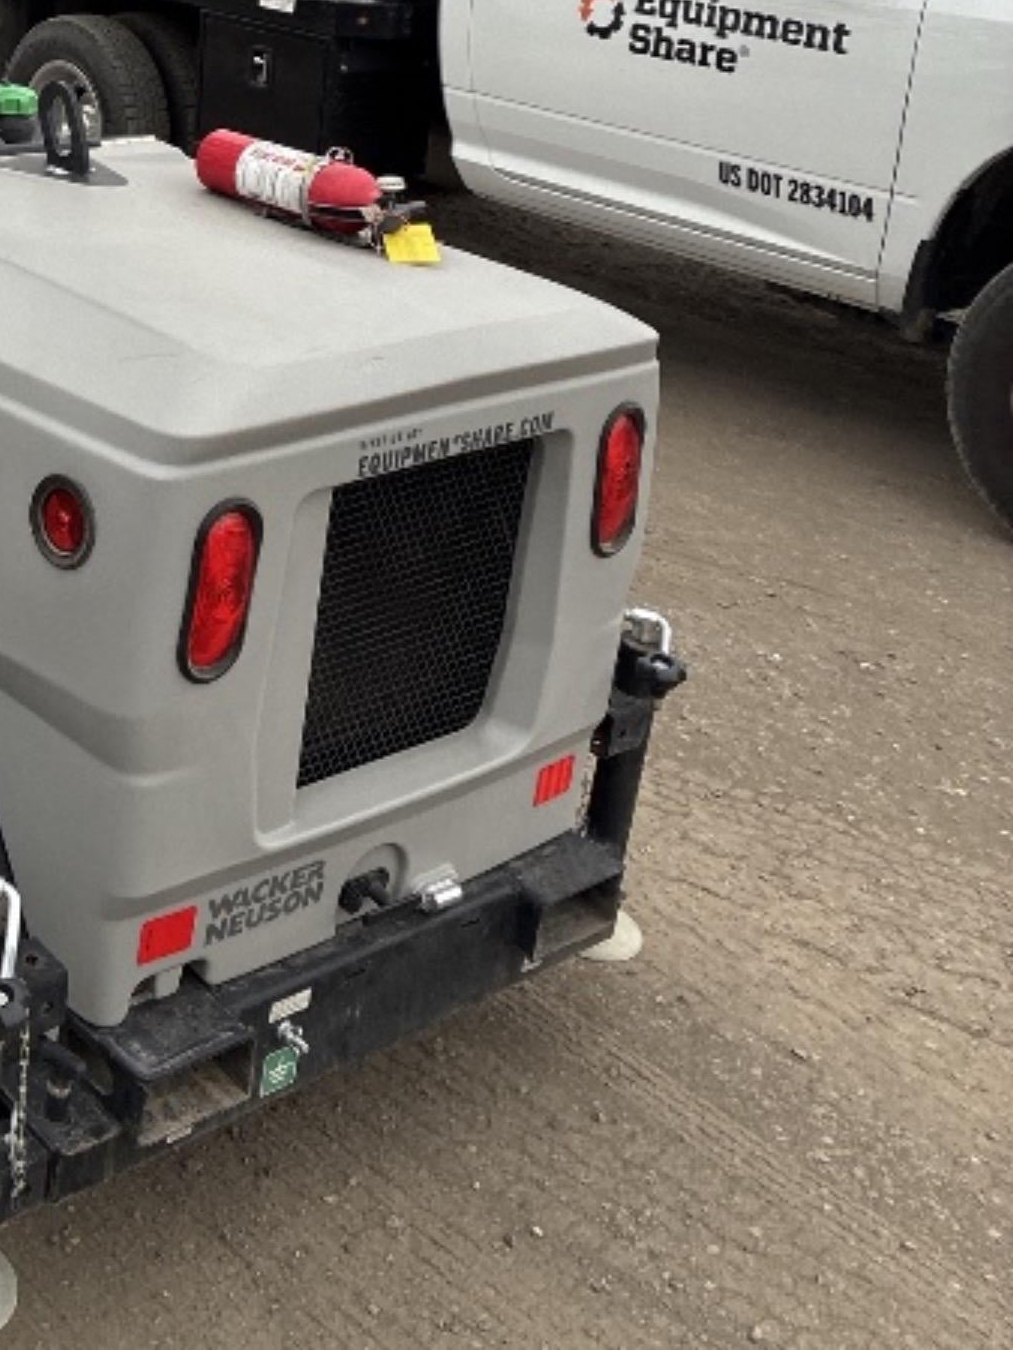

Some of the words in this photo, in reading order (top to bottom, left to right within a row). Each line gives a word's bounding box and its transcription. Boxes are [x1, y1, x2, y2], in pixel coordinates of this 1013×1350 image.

[718, 160, 742, 188] US
[746, 167, 784, 199] DOT
[787, 178, 874, 223] 2834104
[203, 881, 325, 947] NEUSON
[208, 859, 326, 920] WACKER
